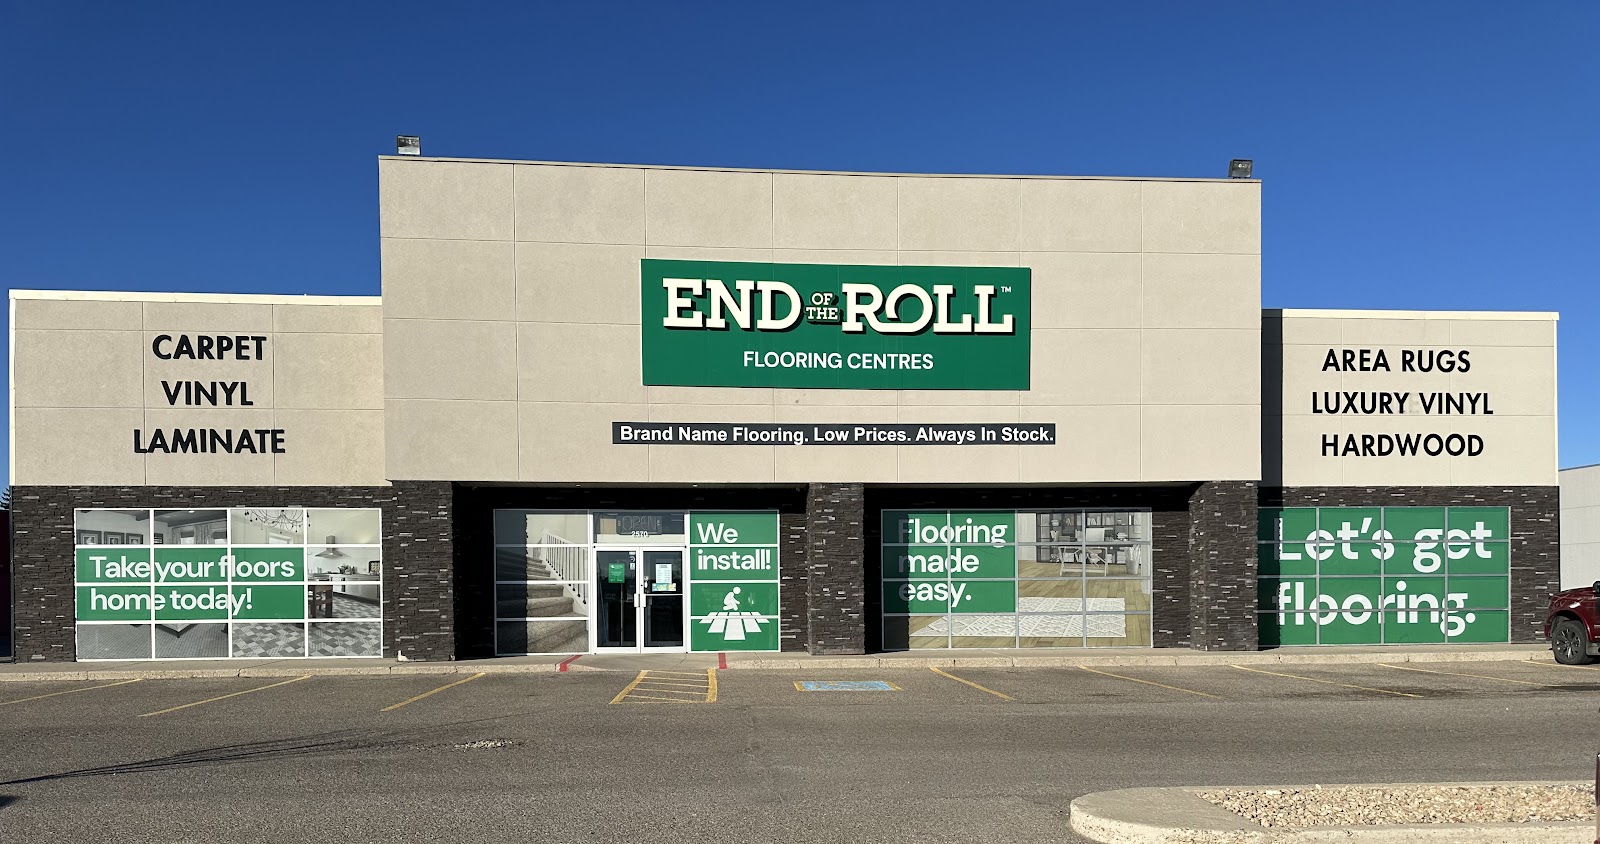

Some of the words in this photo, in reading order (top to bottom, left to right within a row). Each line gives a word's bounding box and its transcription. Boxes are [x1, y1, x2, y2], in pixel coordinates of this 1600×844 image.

[662, 278, 802, 331] END
[811, 292, 833, 306] OF
[841, 283, 1014, 333] ROLL
[805, 306, 839, 321] THE
[152, 334, 267, 361] CARPET
[743, 351, 842, 369] FLOORING
[847, 353, 934, 370] CENTRES
[1322, 349, 1391, 372] AREA
[1402, 350, 1471, 372] RUGS
[161, 380, 254, 406] VINYL
[1312, 391, 1410, 414] LUXURY
[1419, 392, 1494, 415] VINYL
[133, 428, 286, 454] LAMINATE
[620, 426, 673, 441] Brand
[678, 426, 728, 442] Name
[732, 426, 809, 445] Flooring.
[813, 426, 849, 442] Low
[854, 426, 911, 442] Prices.
[916, 426, 976, 445] Always
[981, 426, 996, 442] In
[1001, 426, 1055, 443] Stock.
[1321, 433, 1485, 457] HARDWOOD
[631, 530, 649, 538] 2570
[697, 523, 738, 544] We
[898, 518, 1008, 548] Flooring
[1274, 517, 1395, 561] Let's
[1412, 521, 1493, 573] get
[89, 555, 151, 578] Take
[154, 560, 219, 583] your
[219, 555, 295, 577] floors
[697, 549, 771, 571] install!
[898, 548, 979, 573] made
[90, 588, 165, 610] home
[170, 588, 252, 616] today!
[898, 582, 972, 608] easy.
[1271, 580, 1476, 637] flooring.
